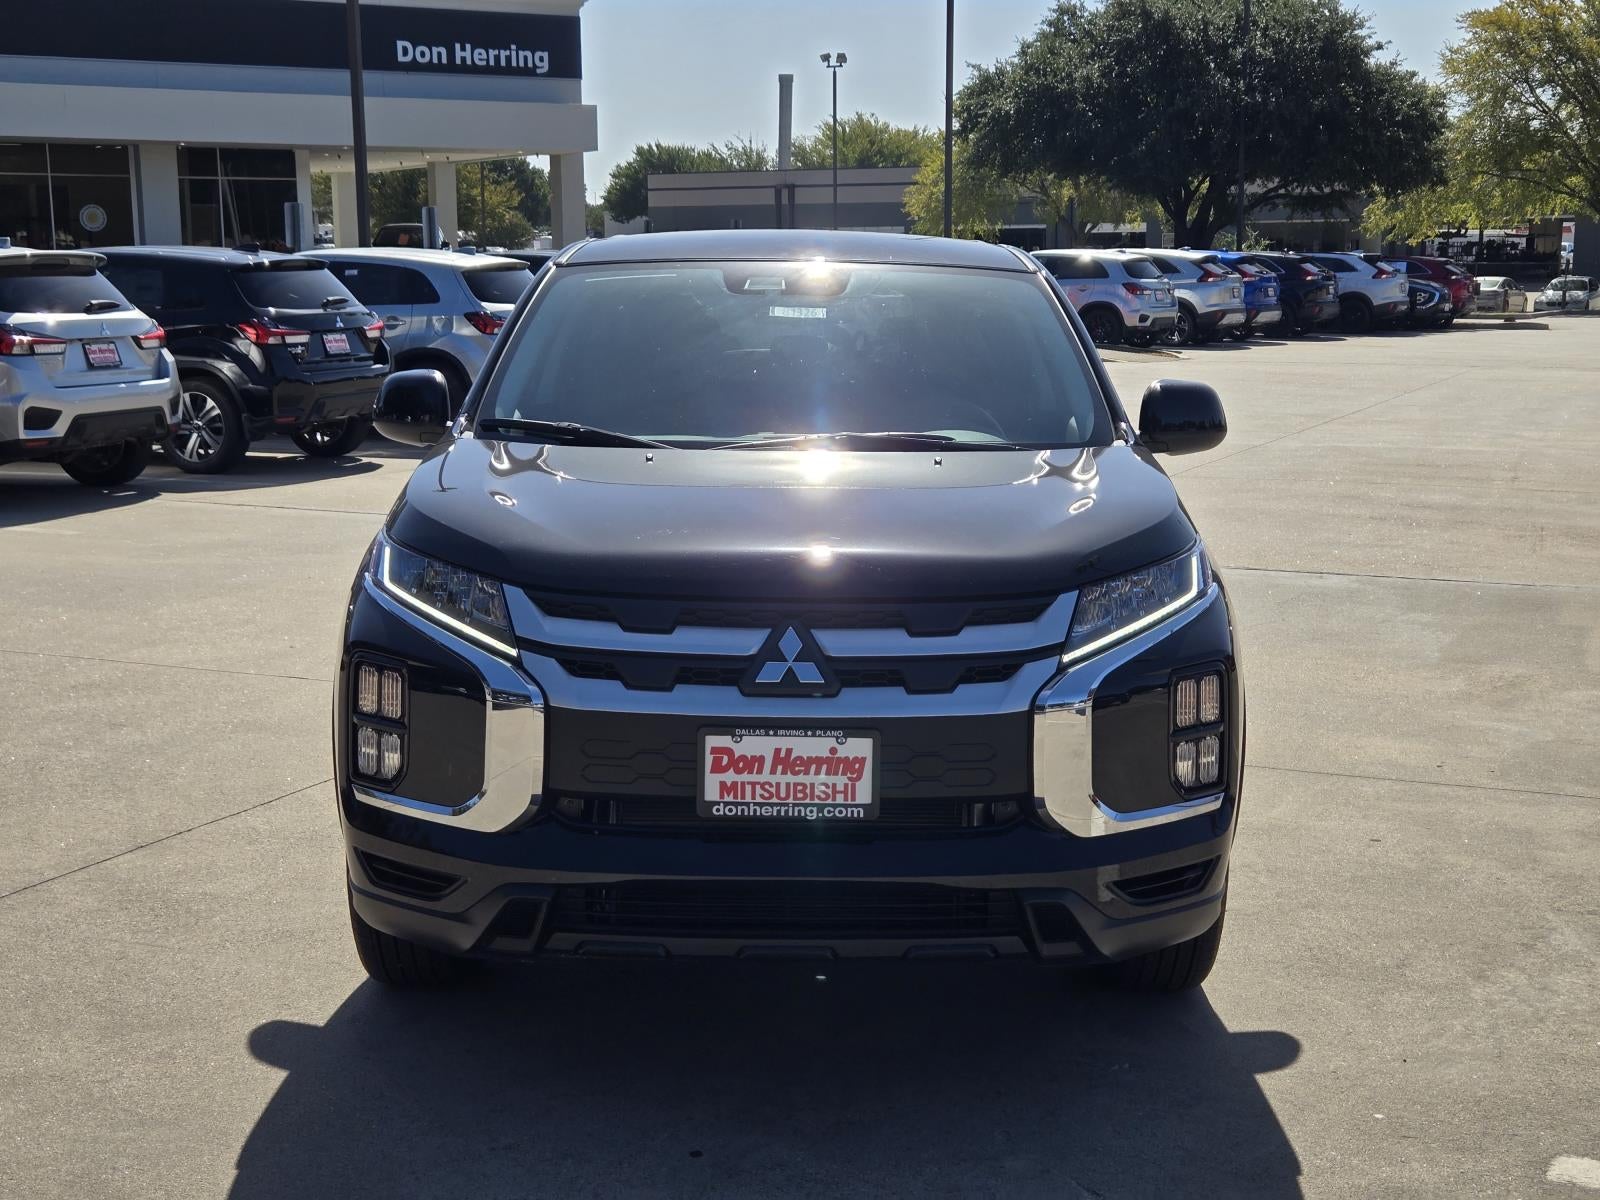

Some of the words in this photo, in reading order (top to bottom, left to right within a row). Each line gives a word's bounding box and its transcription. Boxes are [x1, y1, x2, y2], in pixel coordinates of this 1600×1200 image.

[396, 40, 448, 64] Don
[454, 43, 549, 74] Herring
[735, 728, 766, 736] DALLAS
[777, 729, 805, 737] IRVING
[709, 746, 766, 776] Don
[769, 746, 867, 783] Herring
[719, 780, 857, 802] MITSUBISHI
[712, 803, 864, 820] donherring.com
